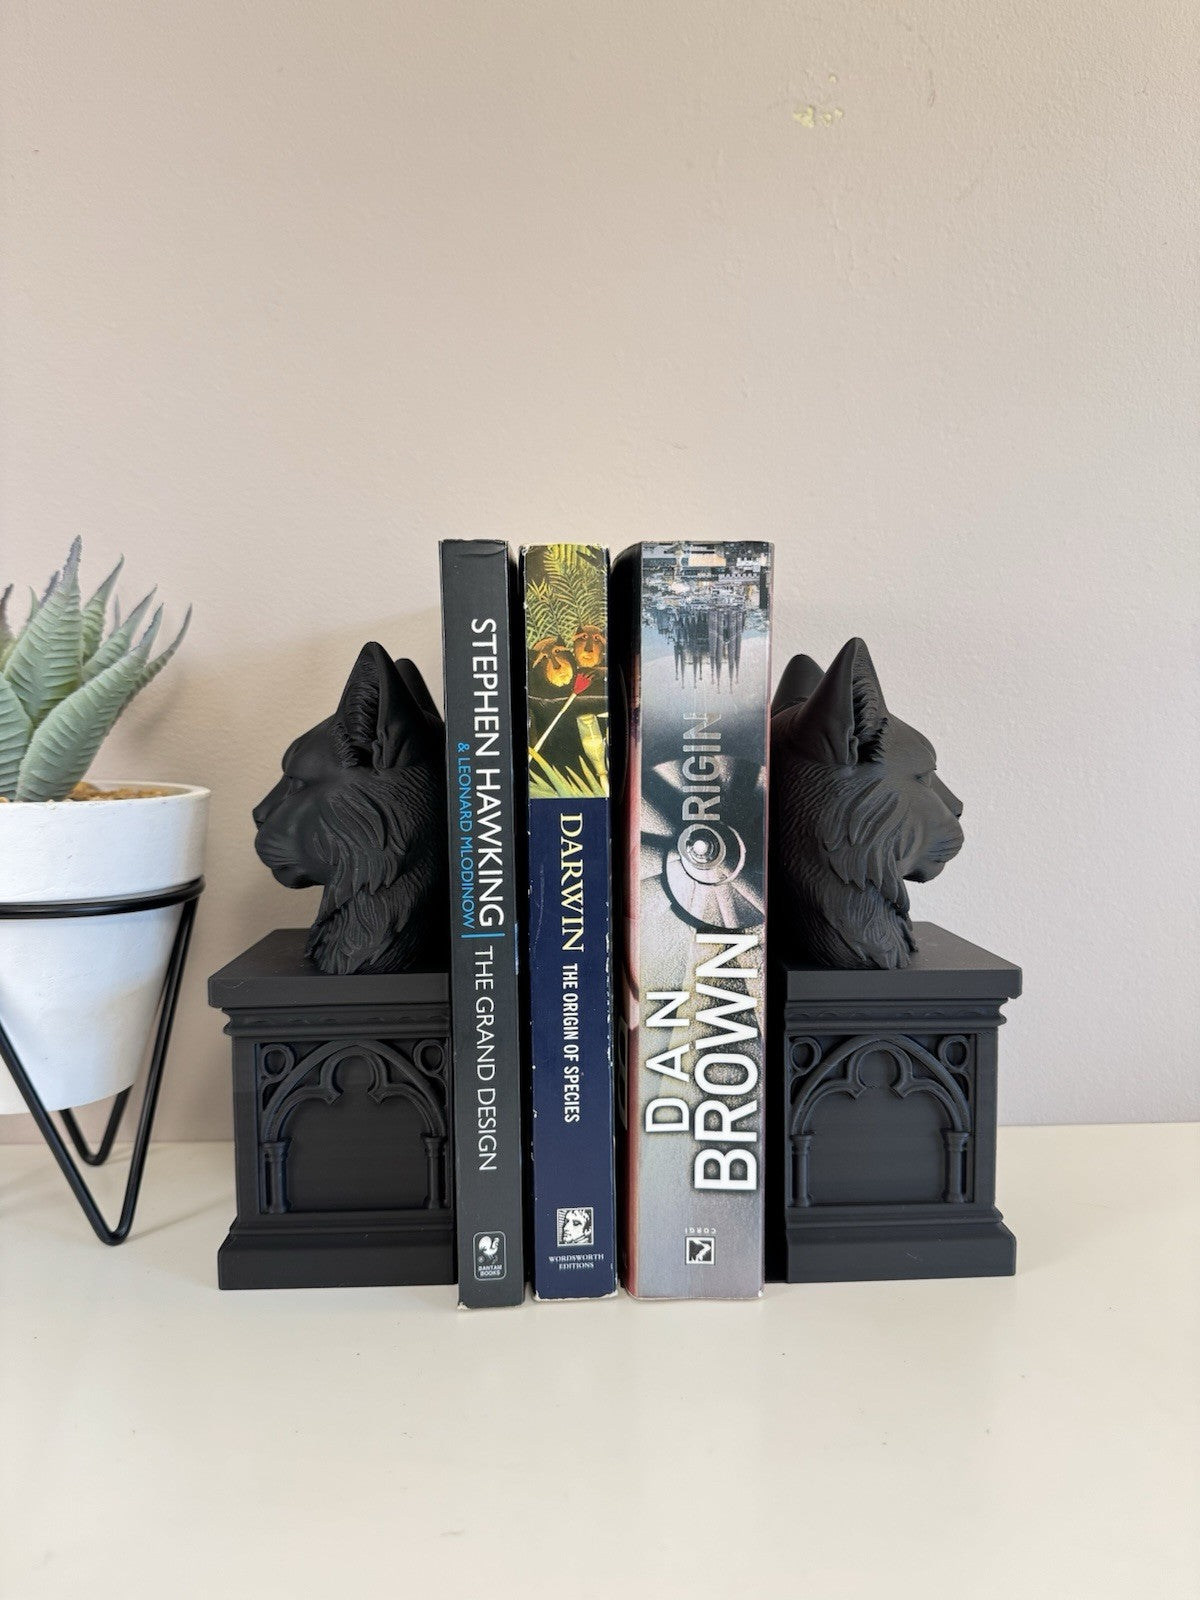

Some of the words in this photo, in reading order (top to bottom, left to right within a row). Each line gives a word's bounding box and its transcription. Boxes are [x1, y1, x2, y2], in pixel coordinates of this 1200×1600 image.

[471, 618, 500, 757] STEPHEN
[457, 742, 470, 753] &
[457, 757, 472, 830] LEONARD
[678, 713, 726, 870] ORIGIN
[460, 836, 476, 929] MLODINOW
[476, 768, 504, 926] HAWKING
[560, 813, 584, 952] DARWIN
[474, 946, 493, 990] THE
[563, 963, 578, 990] THE
[476, 996, 495, 1081] GRAND
[563, 993, 578, 1040] ORIGIN
[563, 1045, 579, 1061] OF
[564, 1065, 580, 1123] SPECIES
[645, 992, 690, 1132] DAN
[694, 933, 759, 1190] BROWN
[477, 1089, 497, 1171] DESIGN
[549, 1253, 604, 1263] WORDSWORTH
[558, 1261, 595, 1271] EDITIONS
